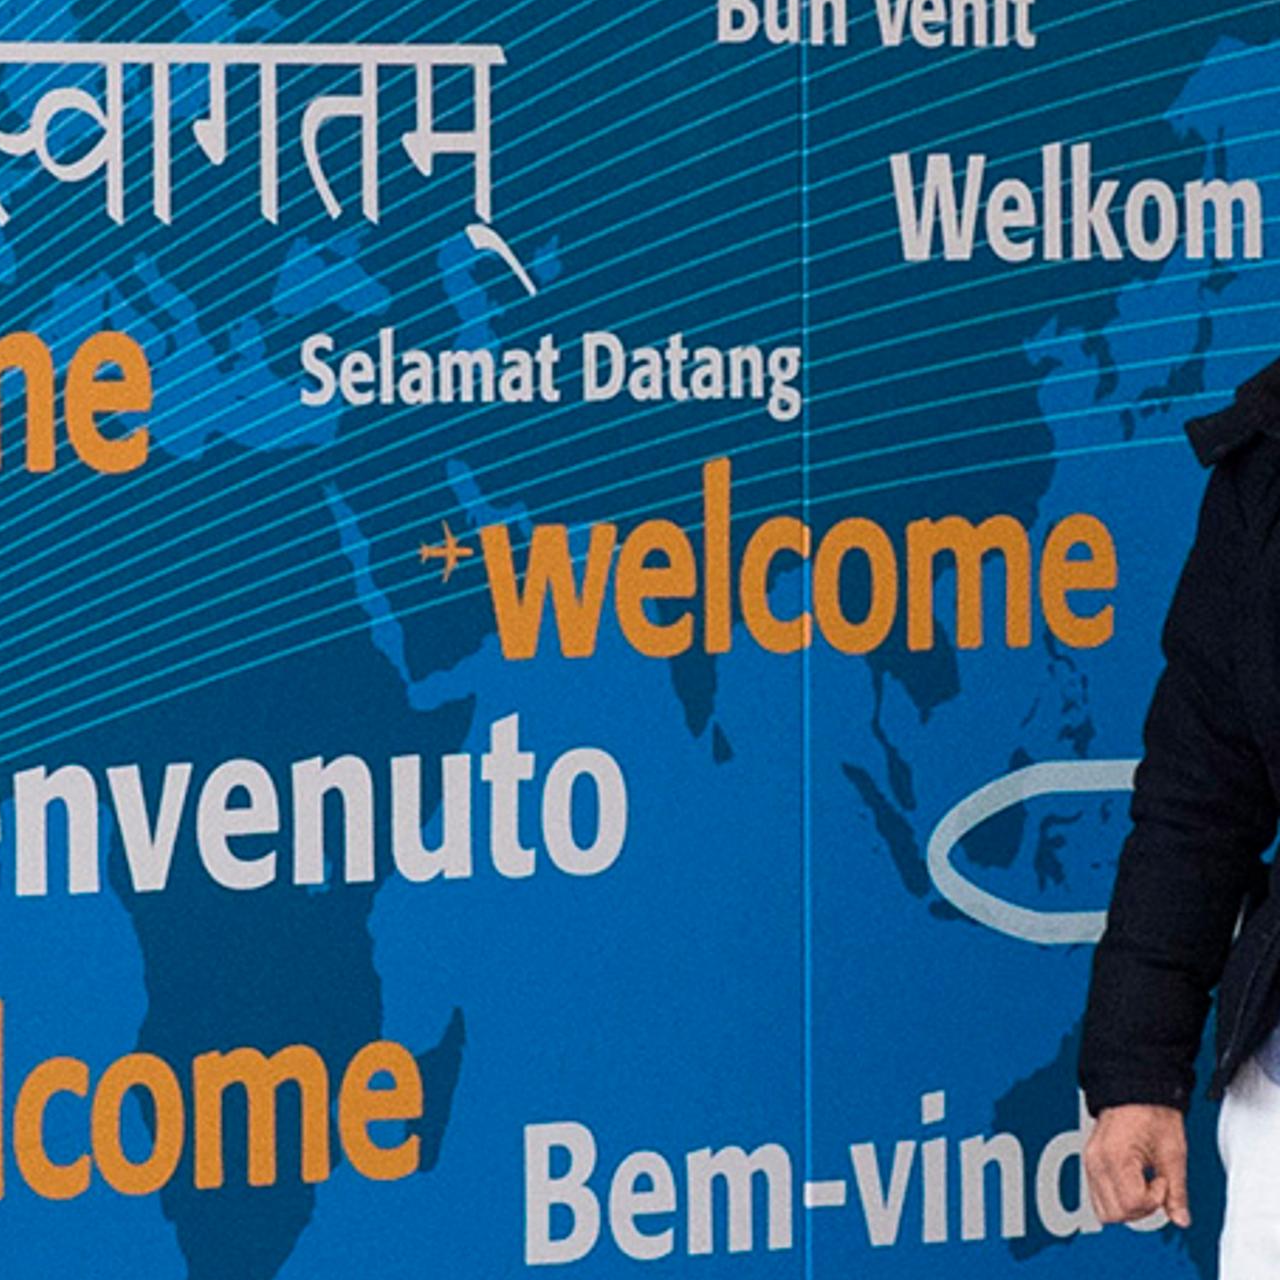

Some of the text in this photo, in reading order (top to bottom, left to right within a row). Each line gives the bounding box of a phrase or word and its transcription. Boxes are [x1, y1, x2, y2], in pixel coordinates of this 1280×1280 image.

[890, 142, 1264, 263] Welkom
[301, 327, 803, 423] Selamat Datang
[479, 457, 1119, 662] welcome
[522, 1089, 1177, 1268] Bem-vind
